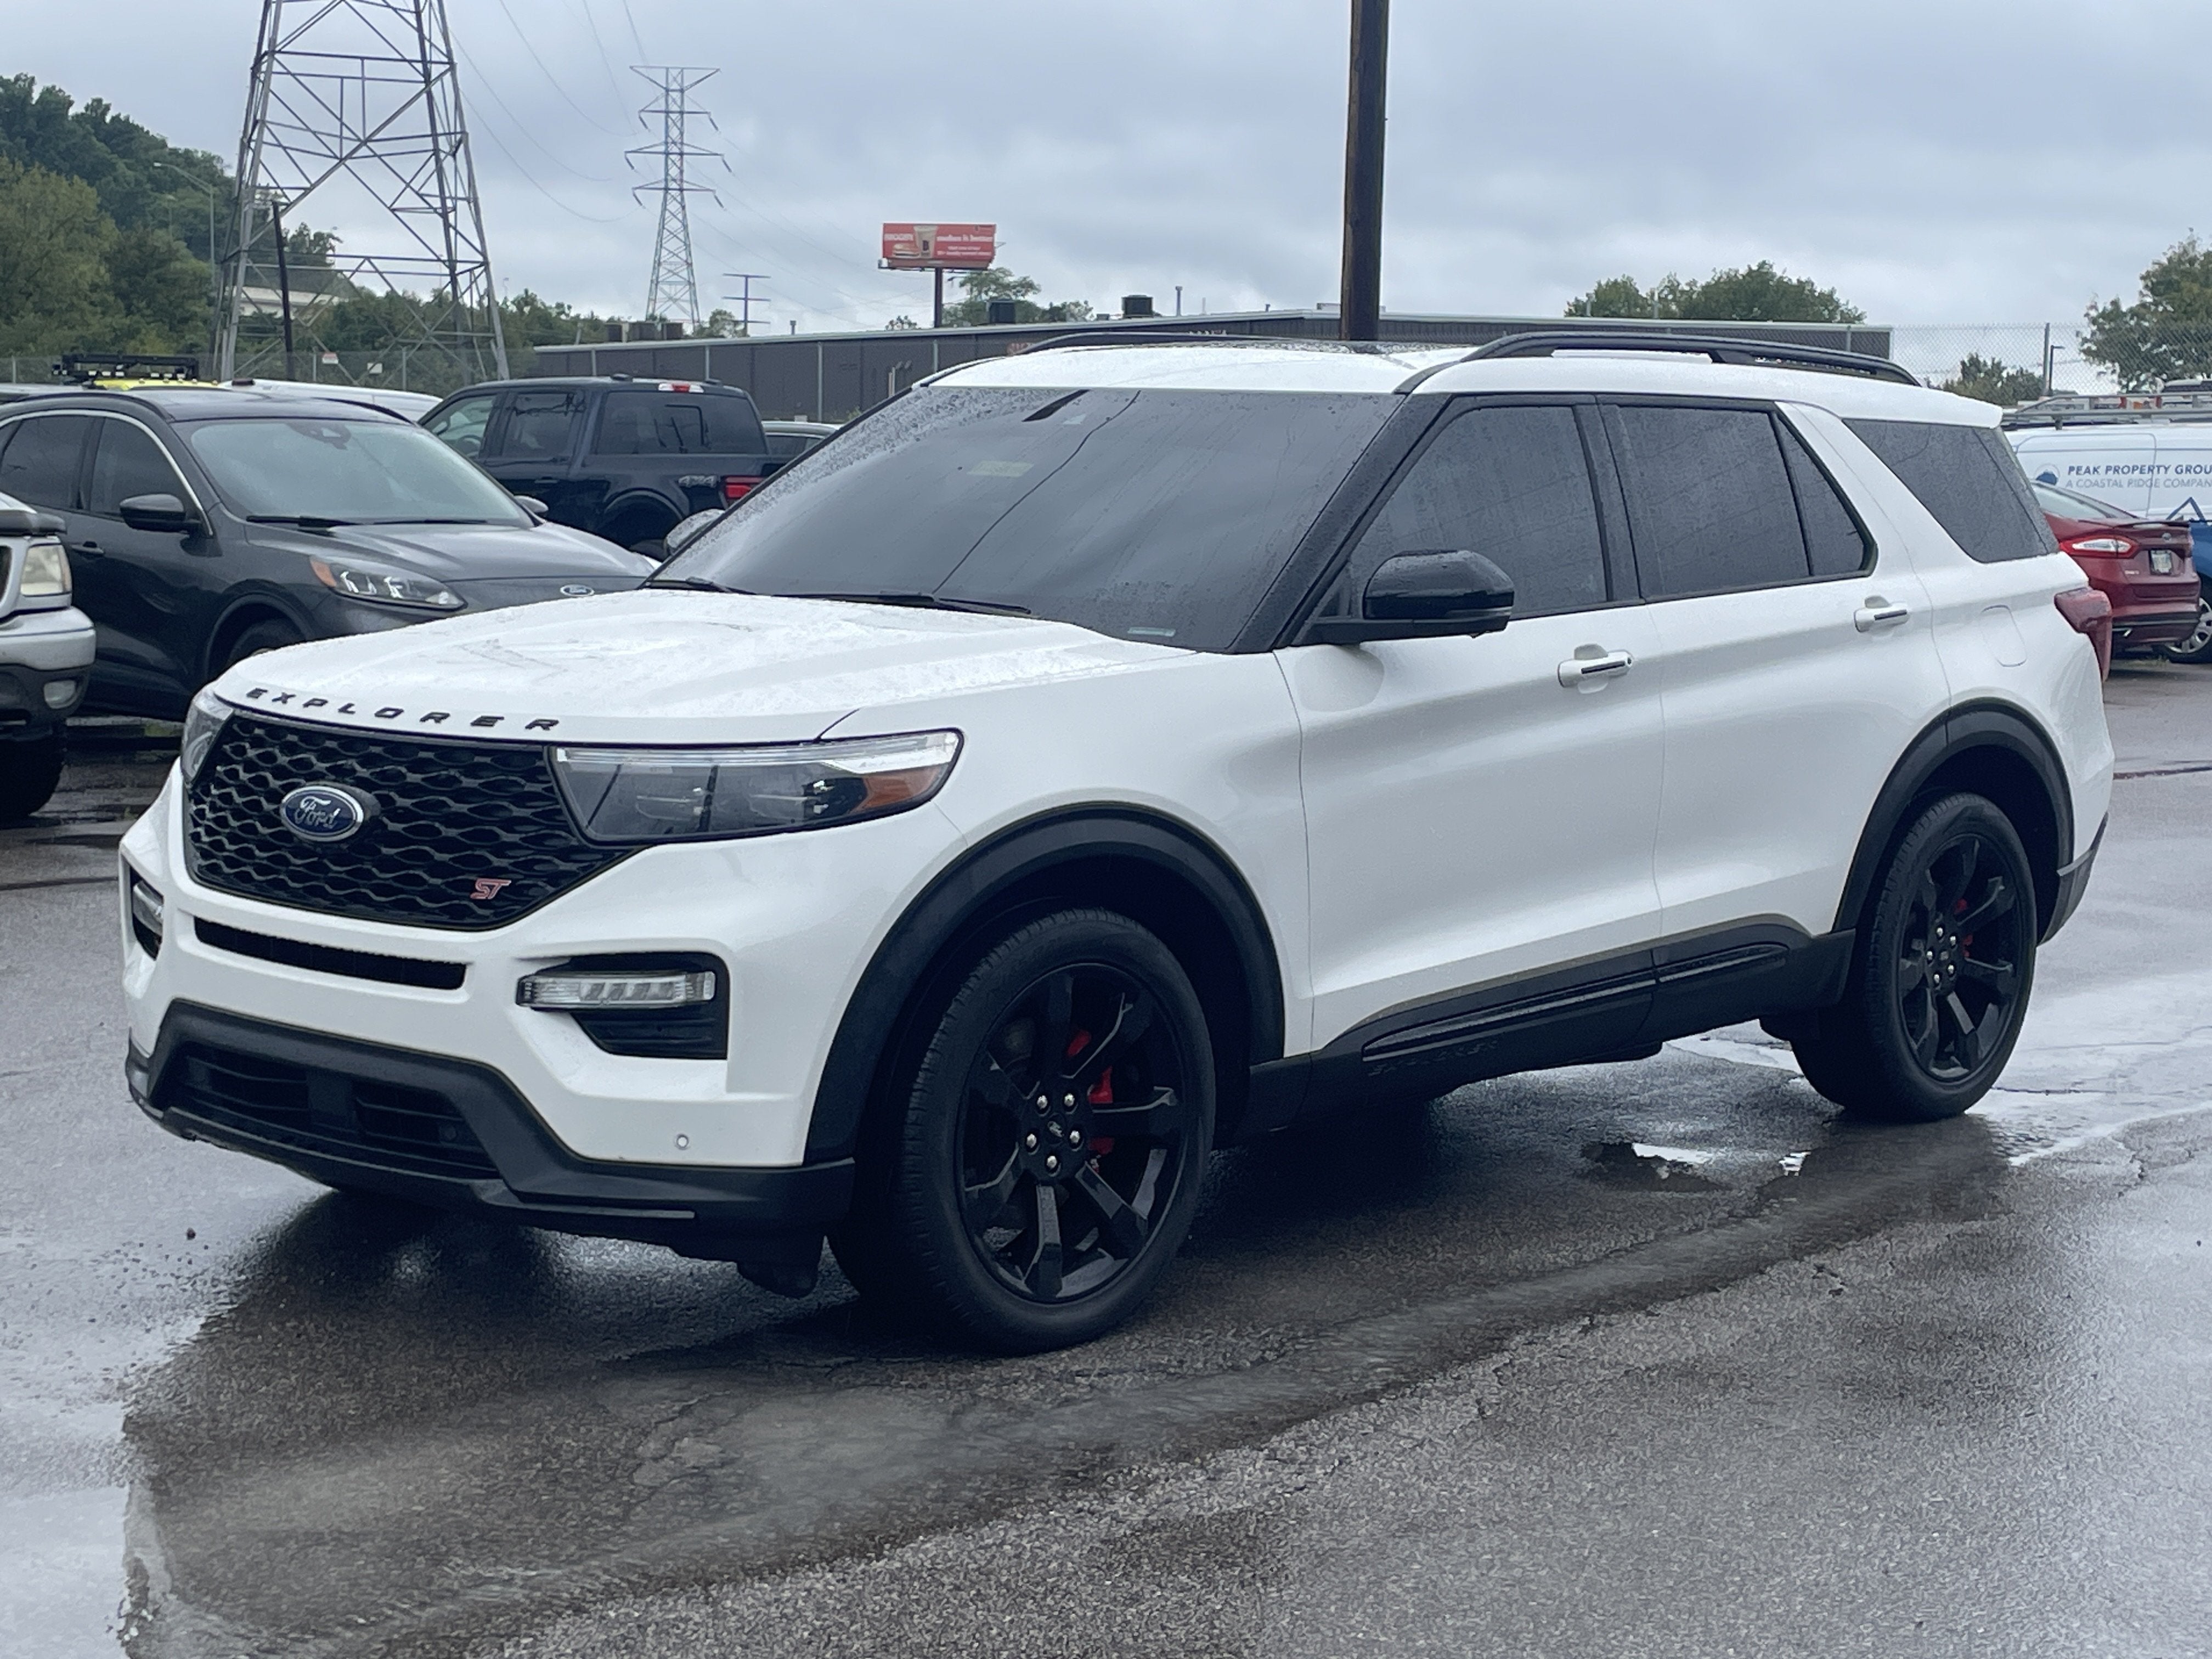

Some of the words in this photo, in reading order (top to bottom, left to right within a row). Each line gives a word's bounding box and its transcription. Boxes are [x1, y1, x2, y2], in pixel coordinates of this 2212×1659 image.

[2067, 465, 2101, 476] PEAK
[2104, 464, 2172, 475] PROPERTY
[2066, 479, 2073, 488] A
[2075, 478, 2124, 488] COASTAL
[245, 687, 560, 731] EXPLORER
[294, 795, 341, 829] Ford
[470, 878, 512, 900] ST
